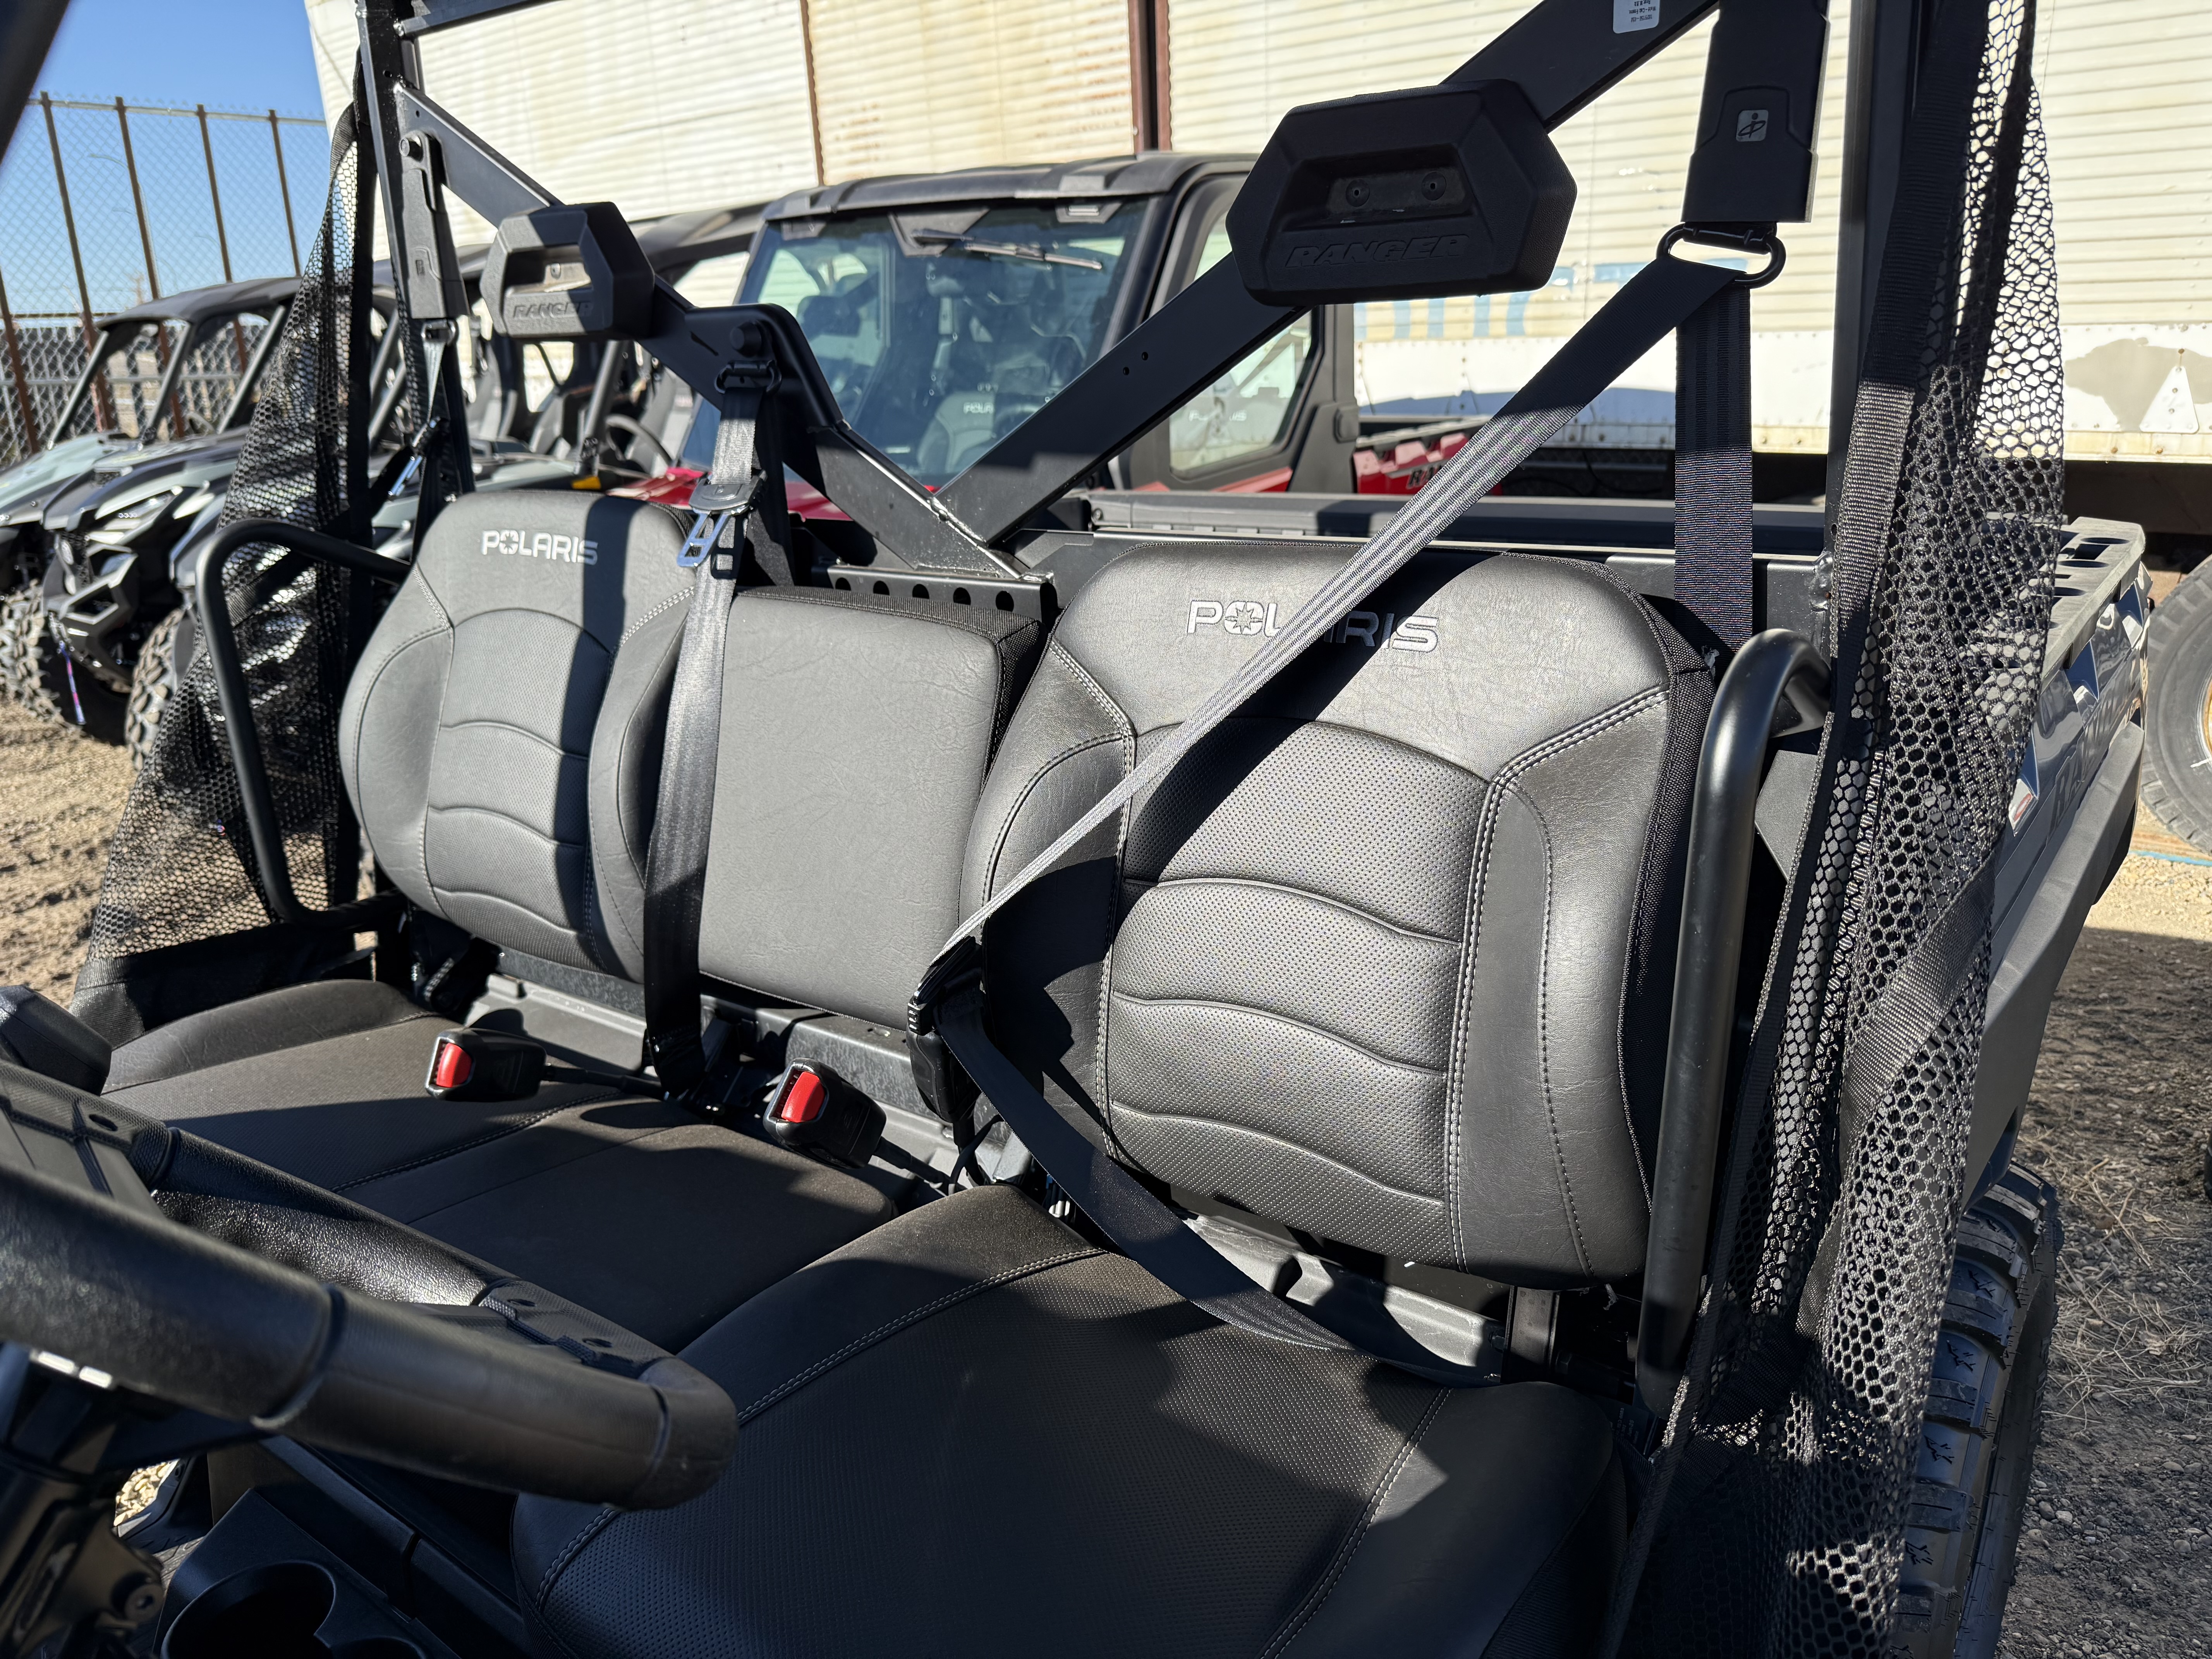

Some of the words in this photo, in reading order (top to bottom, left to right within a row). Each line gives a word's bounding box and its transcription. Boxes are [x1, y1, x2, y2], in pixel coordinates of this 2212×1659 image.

[1285, 234, 1470, 268] RANGER
[513, 301, 594, 319] RANGER
[481, 529, 598, 565] POLARIS
[1187, 599, 1439, 653] POLRIS
